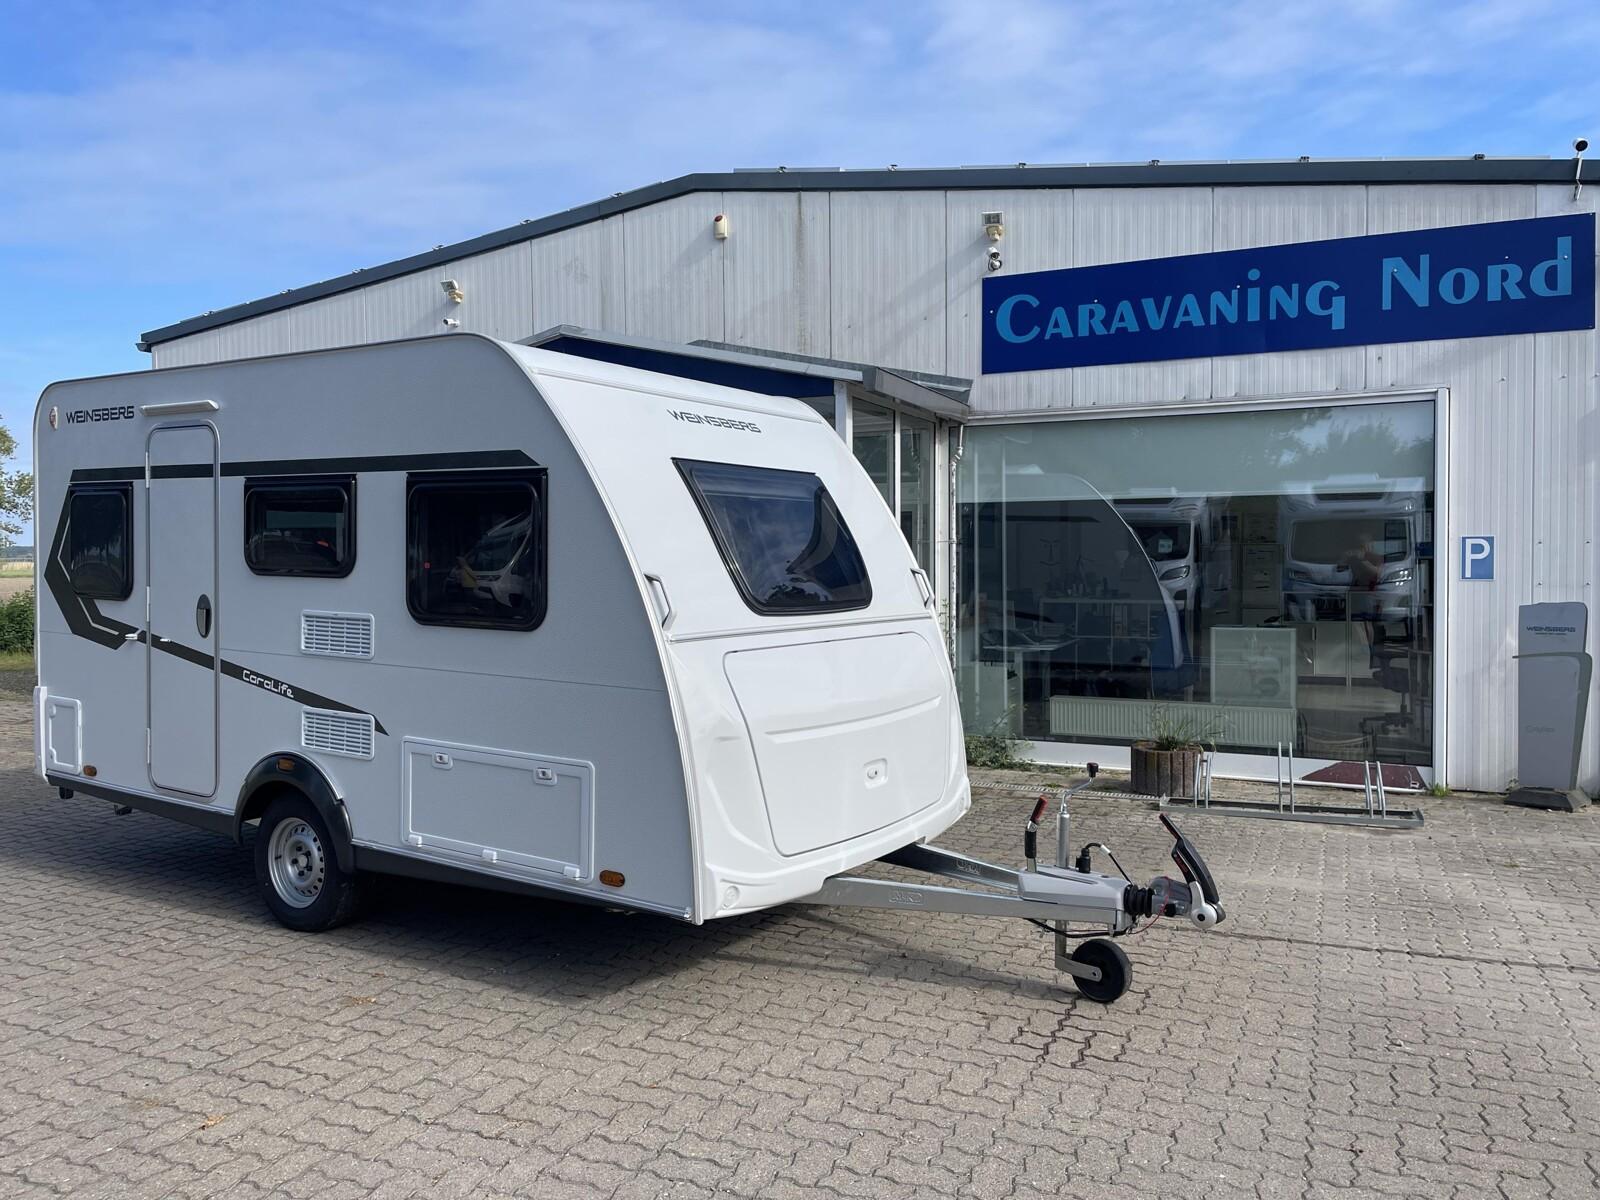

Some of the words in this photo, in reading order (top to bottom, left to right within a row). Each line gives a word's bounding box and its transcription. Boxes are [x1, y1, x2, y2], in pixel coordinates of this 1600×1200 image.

[66, 406, 135, 424] WEINSBERG
[666, 408, 762, 433] WEINSBERG
[1465, 538, 1491, 578] P
[242, 669, 295, 698] CaraLife
